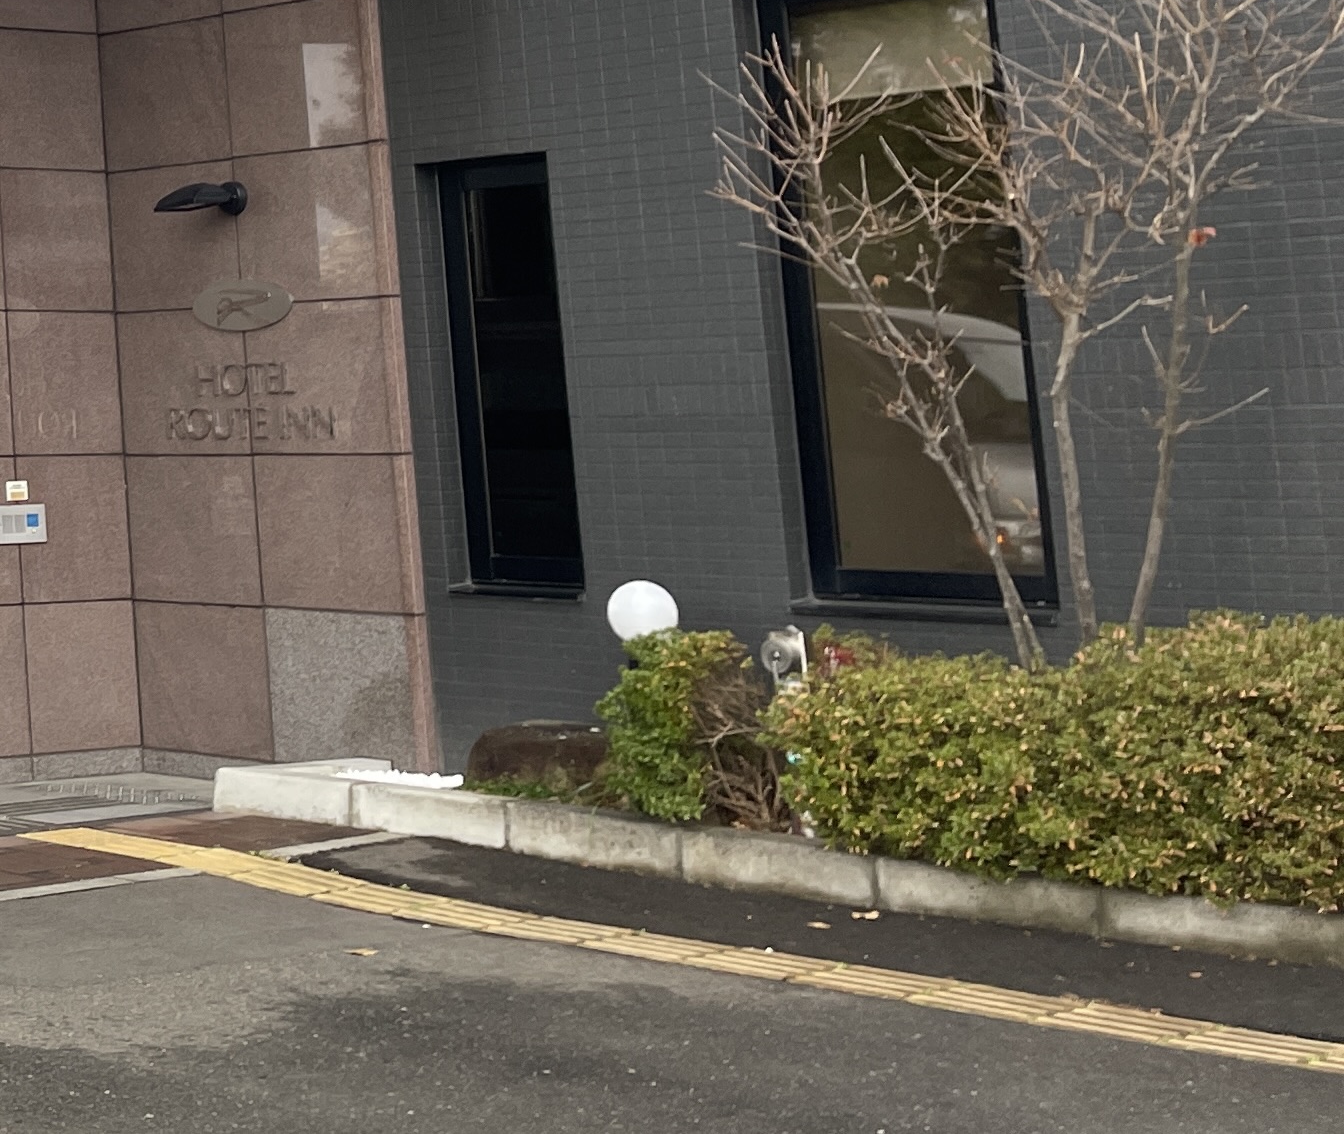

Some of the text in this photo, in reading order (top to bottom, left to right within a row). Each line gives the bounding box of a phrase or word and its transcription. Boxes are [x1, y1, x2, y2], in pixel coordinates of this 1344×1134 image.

[197, 362, 296, 397] HOTEL
[167, 405, 336, 440] ROUTE INN
